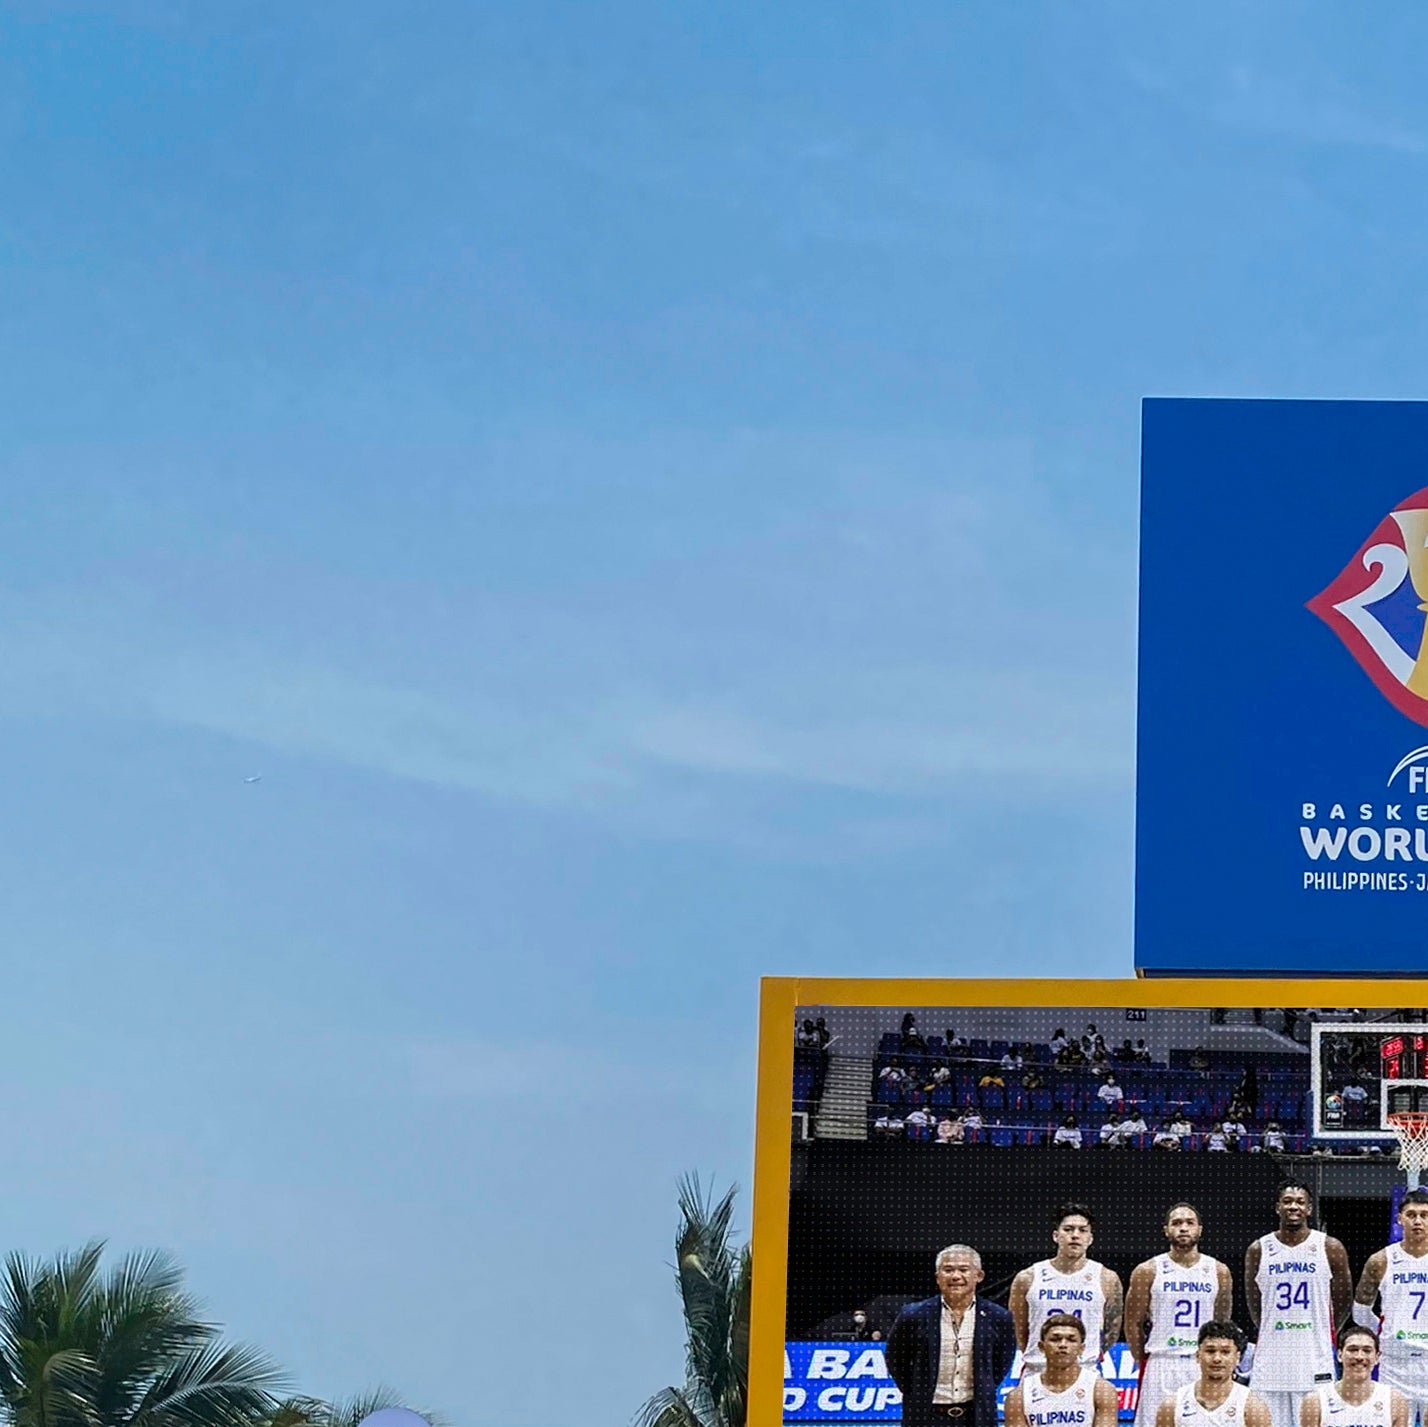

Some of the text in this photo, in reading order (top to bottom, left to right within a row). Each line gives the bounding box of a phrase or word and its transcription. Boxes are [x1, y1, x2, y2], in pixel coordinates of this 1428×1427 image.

[1269, 1263, 1316, 1275] PILIPINAS
[1163, 1281, 1212, 1293] PILIPINAS
[1039, 1289, 1093, 1302] PILIPINAS
[1276, 1282, 1310, 1310] 34
[1409, 1291, 1426, 1319] 7
[1174, 1300, 1200, 1327] 21
[1285, 1321, 1312, 1330] Smart
[817, 1387, 903, 1412] CUP
[1029, 1410, 1085, 1426] PILIPINAS
